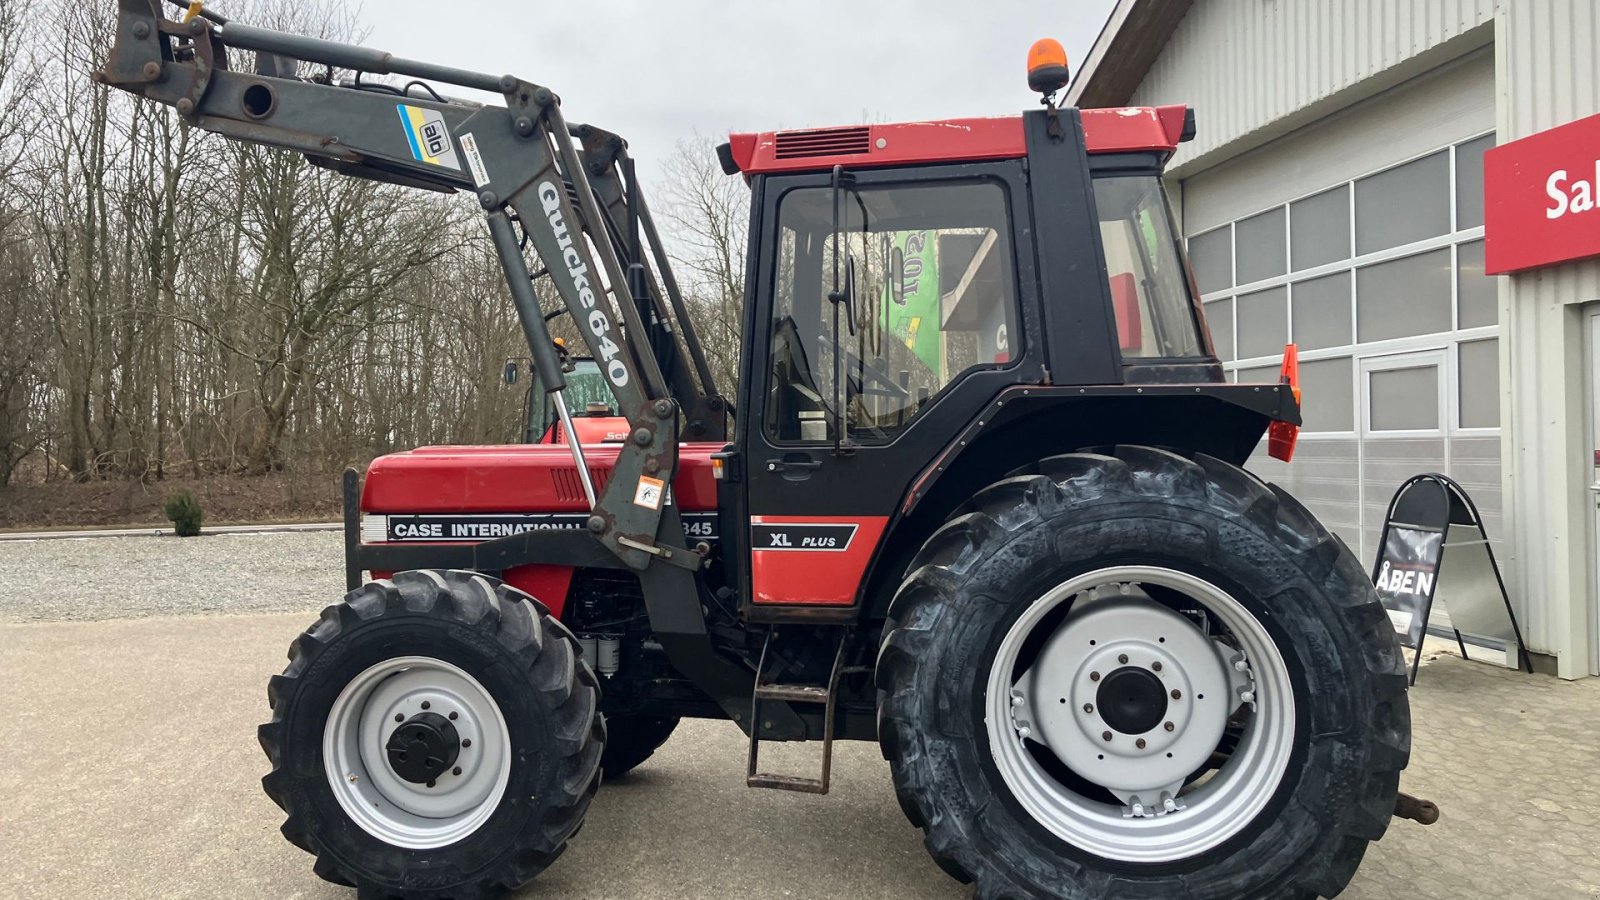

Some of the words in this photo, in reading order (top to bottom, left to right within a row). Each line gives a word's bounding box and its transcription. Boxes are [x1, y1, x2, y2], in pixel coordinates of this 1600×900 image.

[538, 181, 595, 309] Quicke
[588, 309, 629, 388] 640
[394, 523, 443, 537] CASE
[770, 533, 792, 547] XL
[801, 537, 836, 547] PLUS
[1376, 560, 1434, 597] ÅBEN
